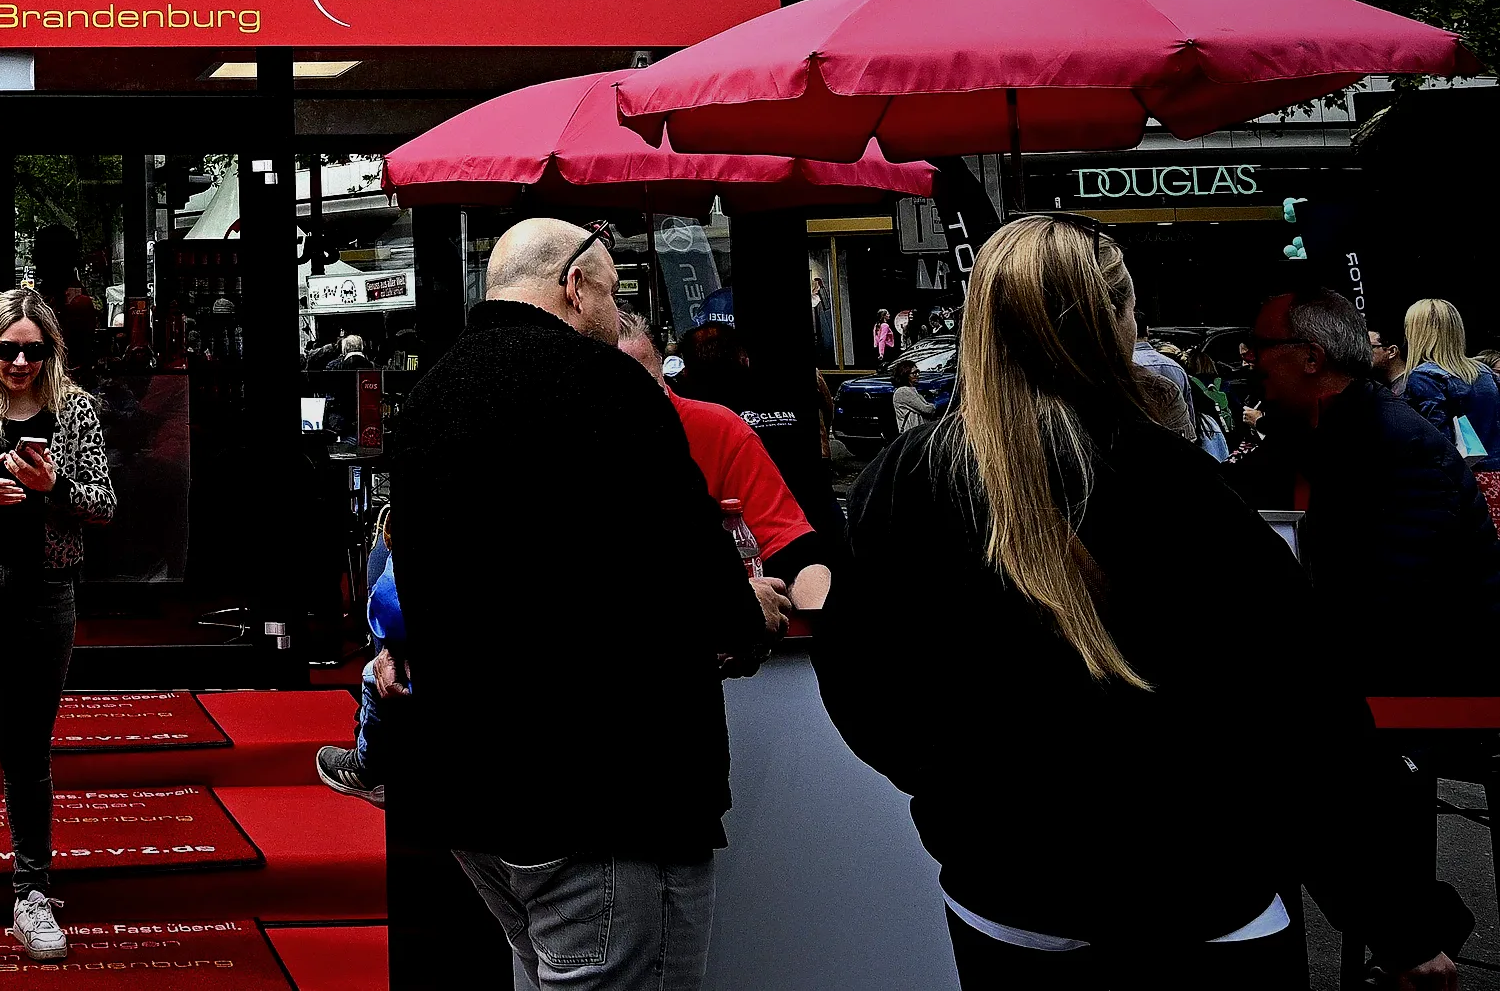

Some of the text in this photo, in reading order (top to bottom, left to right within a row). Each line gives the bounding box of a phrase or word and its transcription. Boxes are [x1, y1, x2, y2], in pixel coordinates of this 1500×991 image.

[1078, 164, 1257, 197] DOUGLAS
[760, 411, 796, 419] CLEAN
[86, 791, 129, 799] Fast
[132, 787, 199, 797] überall.
[113, 924, 163, 934] Fast
[167, 921, 242, 933] überall.
